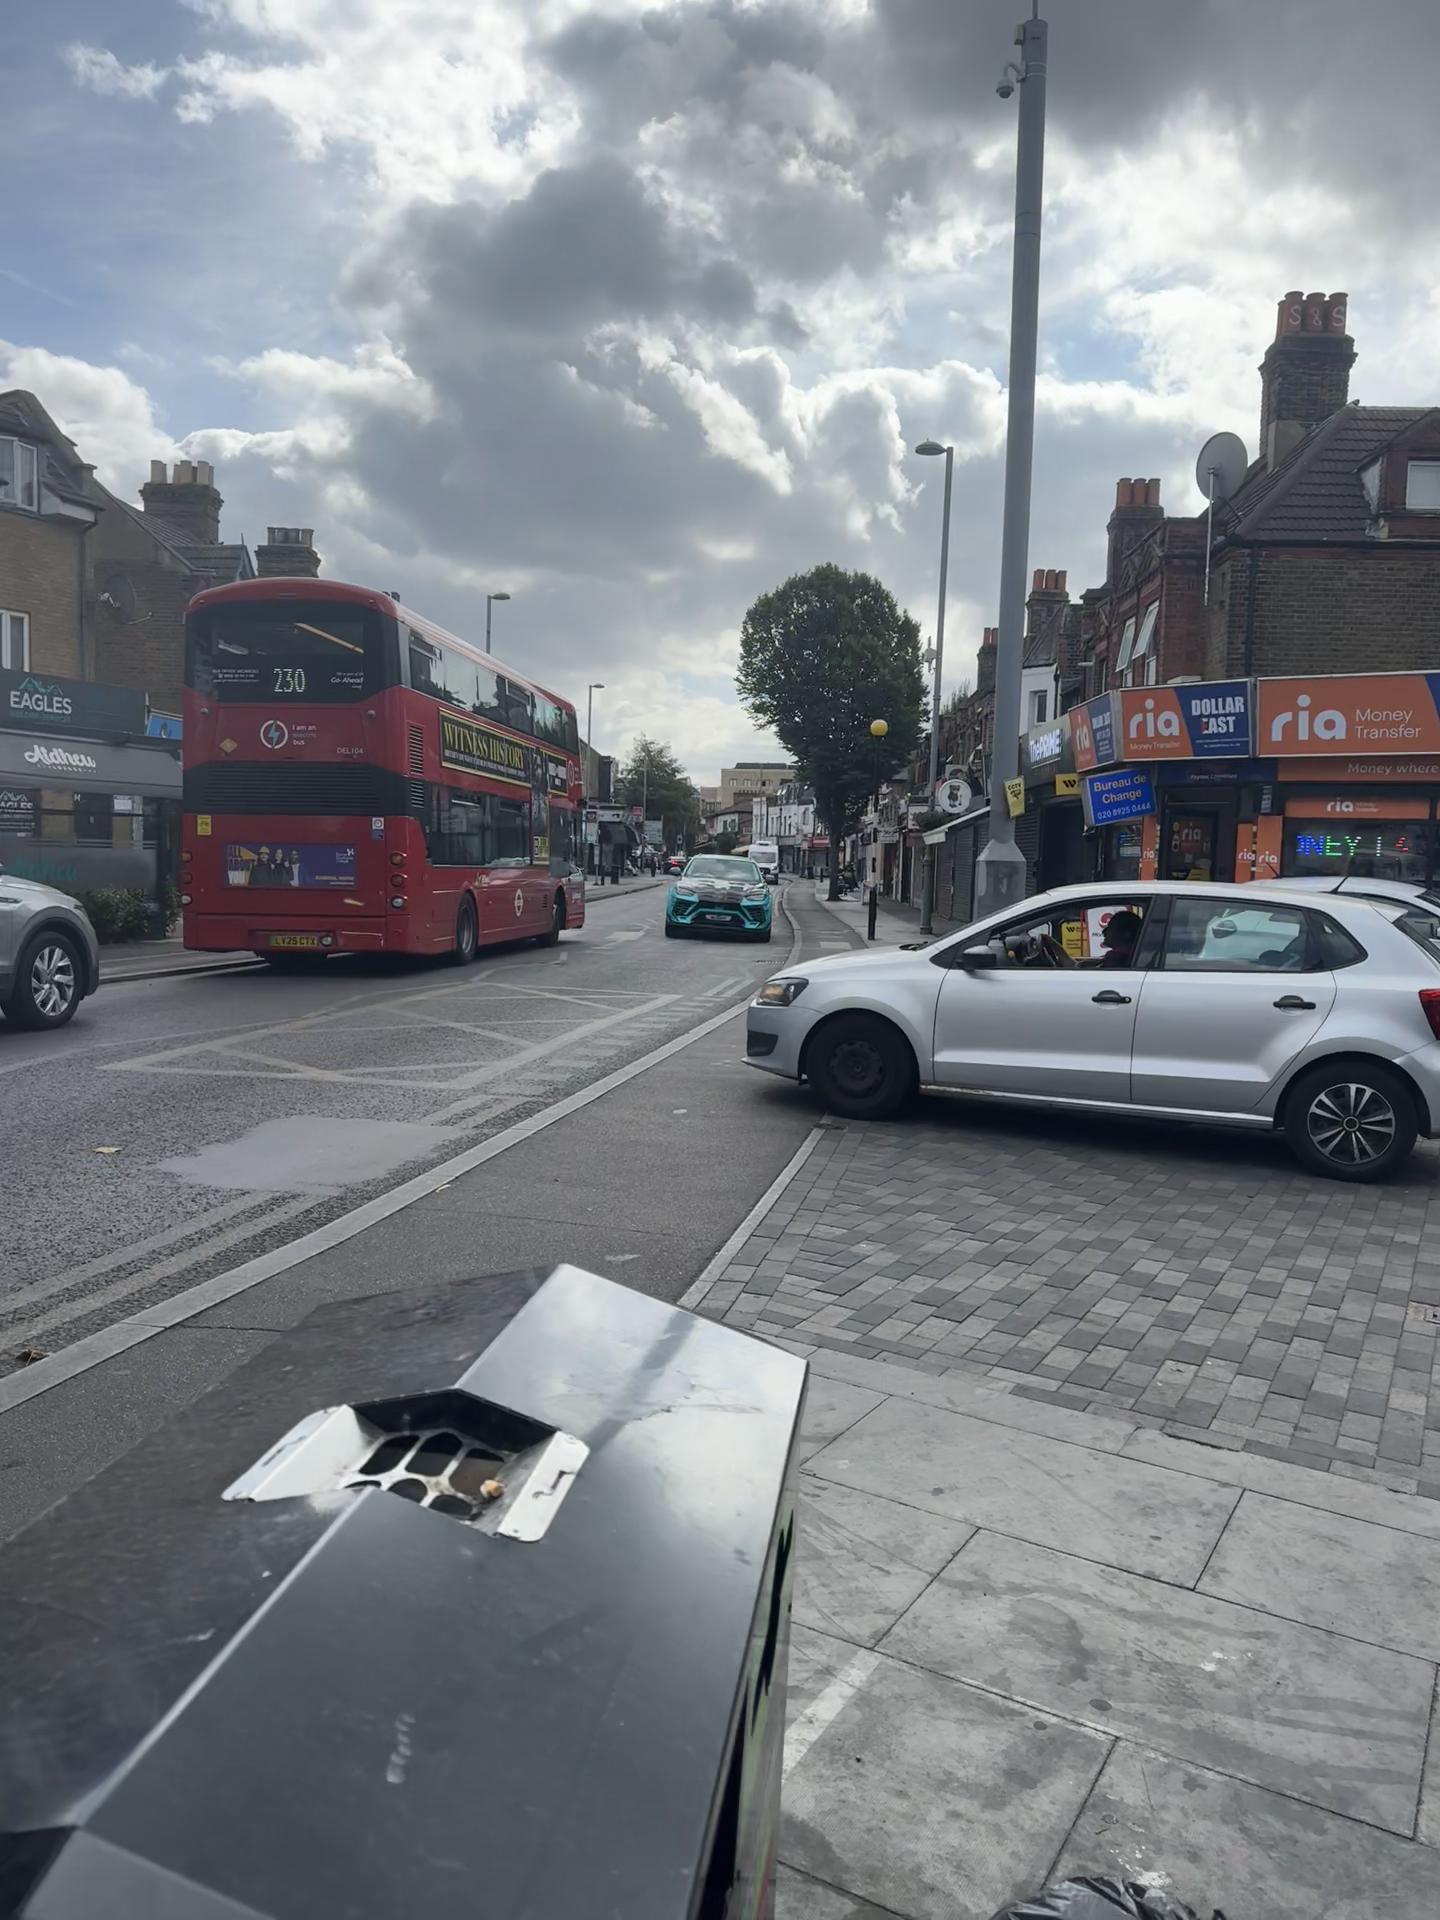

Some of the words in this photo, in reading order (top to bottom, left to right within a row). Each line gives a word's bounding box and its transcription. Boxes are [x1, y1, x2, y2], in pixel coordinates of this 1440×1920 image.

[273, 668, 306, 692] 230
[10, 690, 72, 715] EAGLES
[1191, 696, 1244, 716] DOLLAR
[1129, 698, 1180, 738] ria
[1201, 716, 1236, 734] EAST
[1272, 694, 1347, 742] ria
[1355, 708, 1413, 724] Money
[1076, 714, 1090, 751] ria
[1355, 724, 1422, 740] Transfer
[444, 721, 488, 760] WITNESS
[490, 738, 524, 769] HISTORY
[1348, 763, 1393, 776] Money
[1396, 762, 1440, 774] where
[1008, 782, 1022, 791] CCTV
[1094, 778, 1131, 792] Bureau
[1134, 774, 1146, 784] de
[1102, 789, 1142, 804] Change
[1326, 797, 1354, 812] ria
[1097, 810, 1112, 820] 020
[1112, 806, 1130, 816] 8925
[1131, 802, 1152, 812] 0444
[1182, 822, 1200, 840] ria
[1143, 848, 1155, 859] ria
[1238, 848, 1256, 860] ria
[1258, 851, 1278, 864] ria
